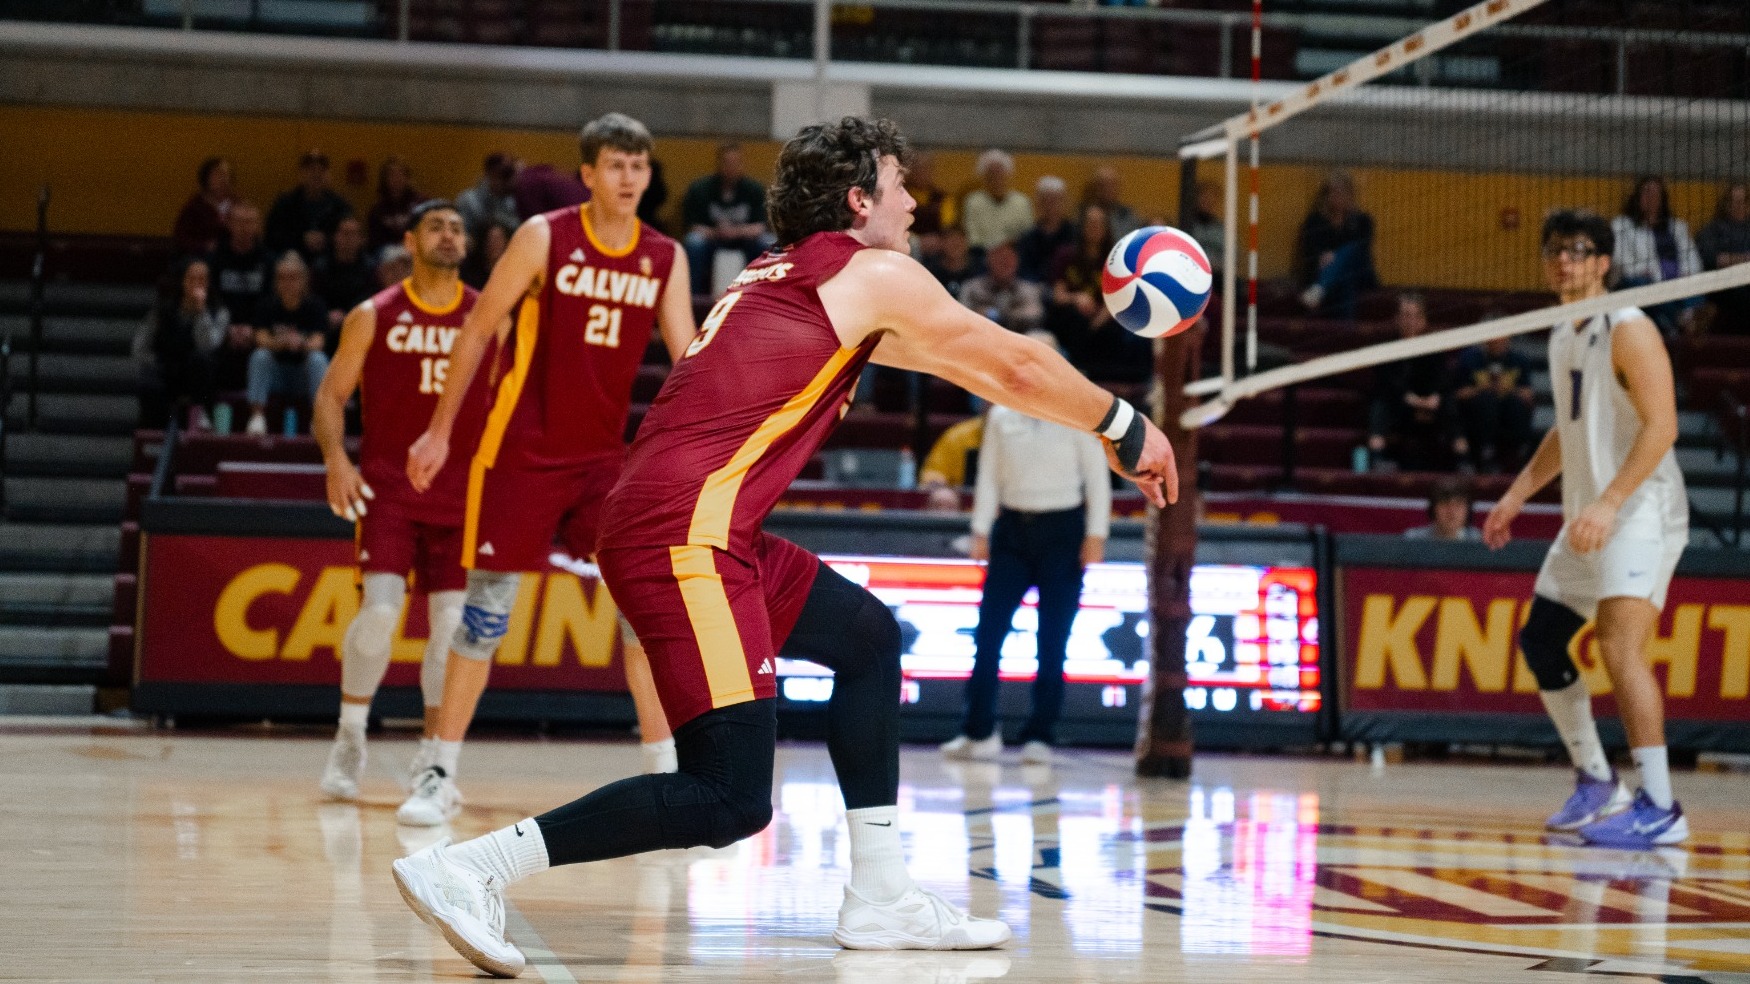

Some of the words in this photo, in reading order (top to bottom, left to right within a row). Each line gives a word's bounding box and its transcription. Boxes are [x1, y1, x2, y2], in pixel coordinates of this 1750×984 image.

[555, 264, 660, 308] CALVIN
[386, 325, 460, 354] CALV
[584, 305, 622, 347] 21
[684, 290, 743, 358] 9
[213, 563, 618, 667] CAIN
